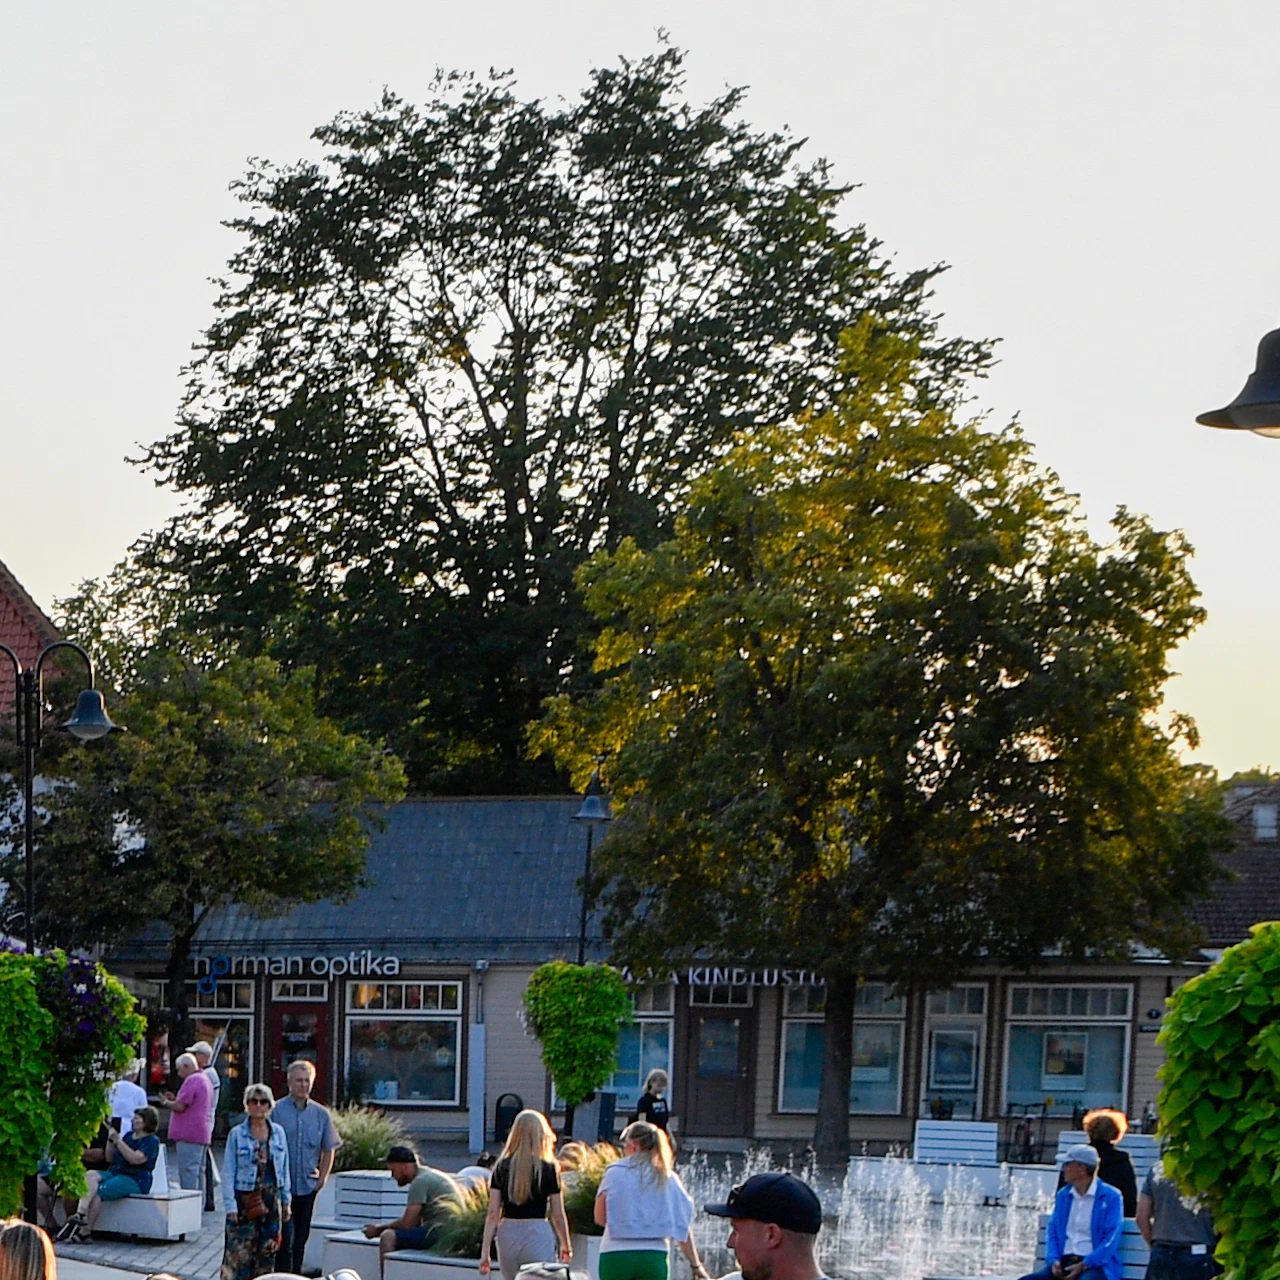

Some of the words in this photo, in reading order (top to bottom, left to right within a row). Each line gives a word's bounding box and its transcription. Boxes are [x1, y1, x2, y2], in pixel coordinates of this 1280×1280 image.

[194, 956, 304, 979] norman
[310, 950, 400, 982] optika
[688, 966, 826, 987] KINDLUSTU
